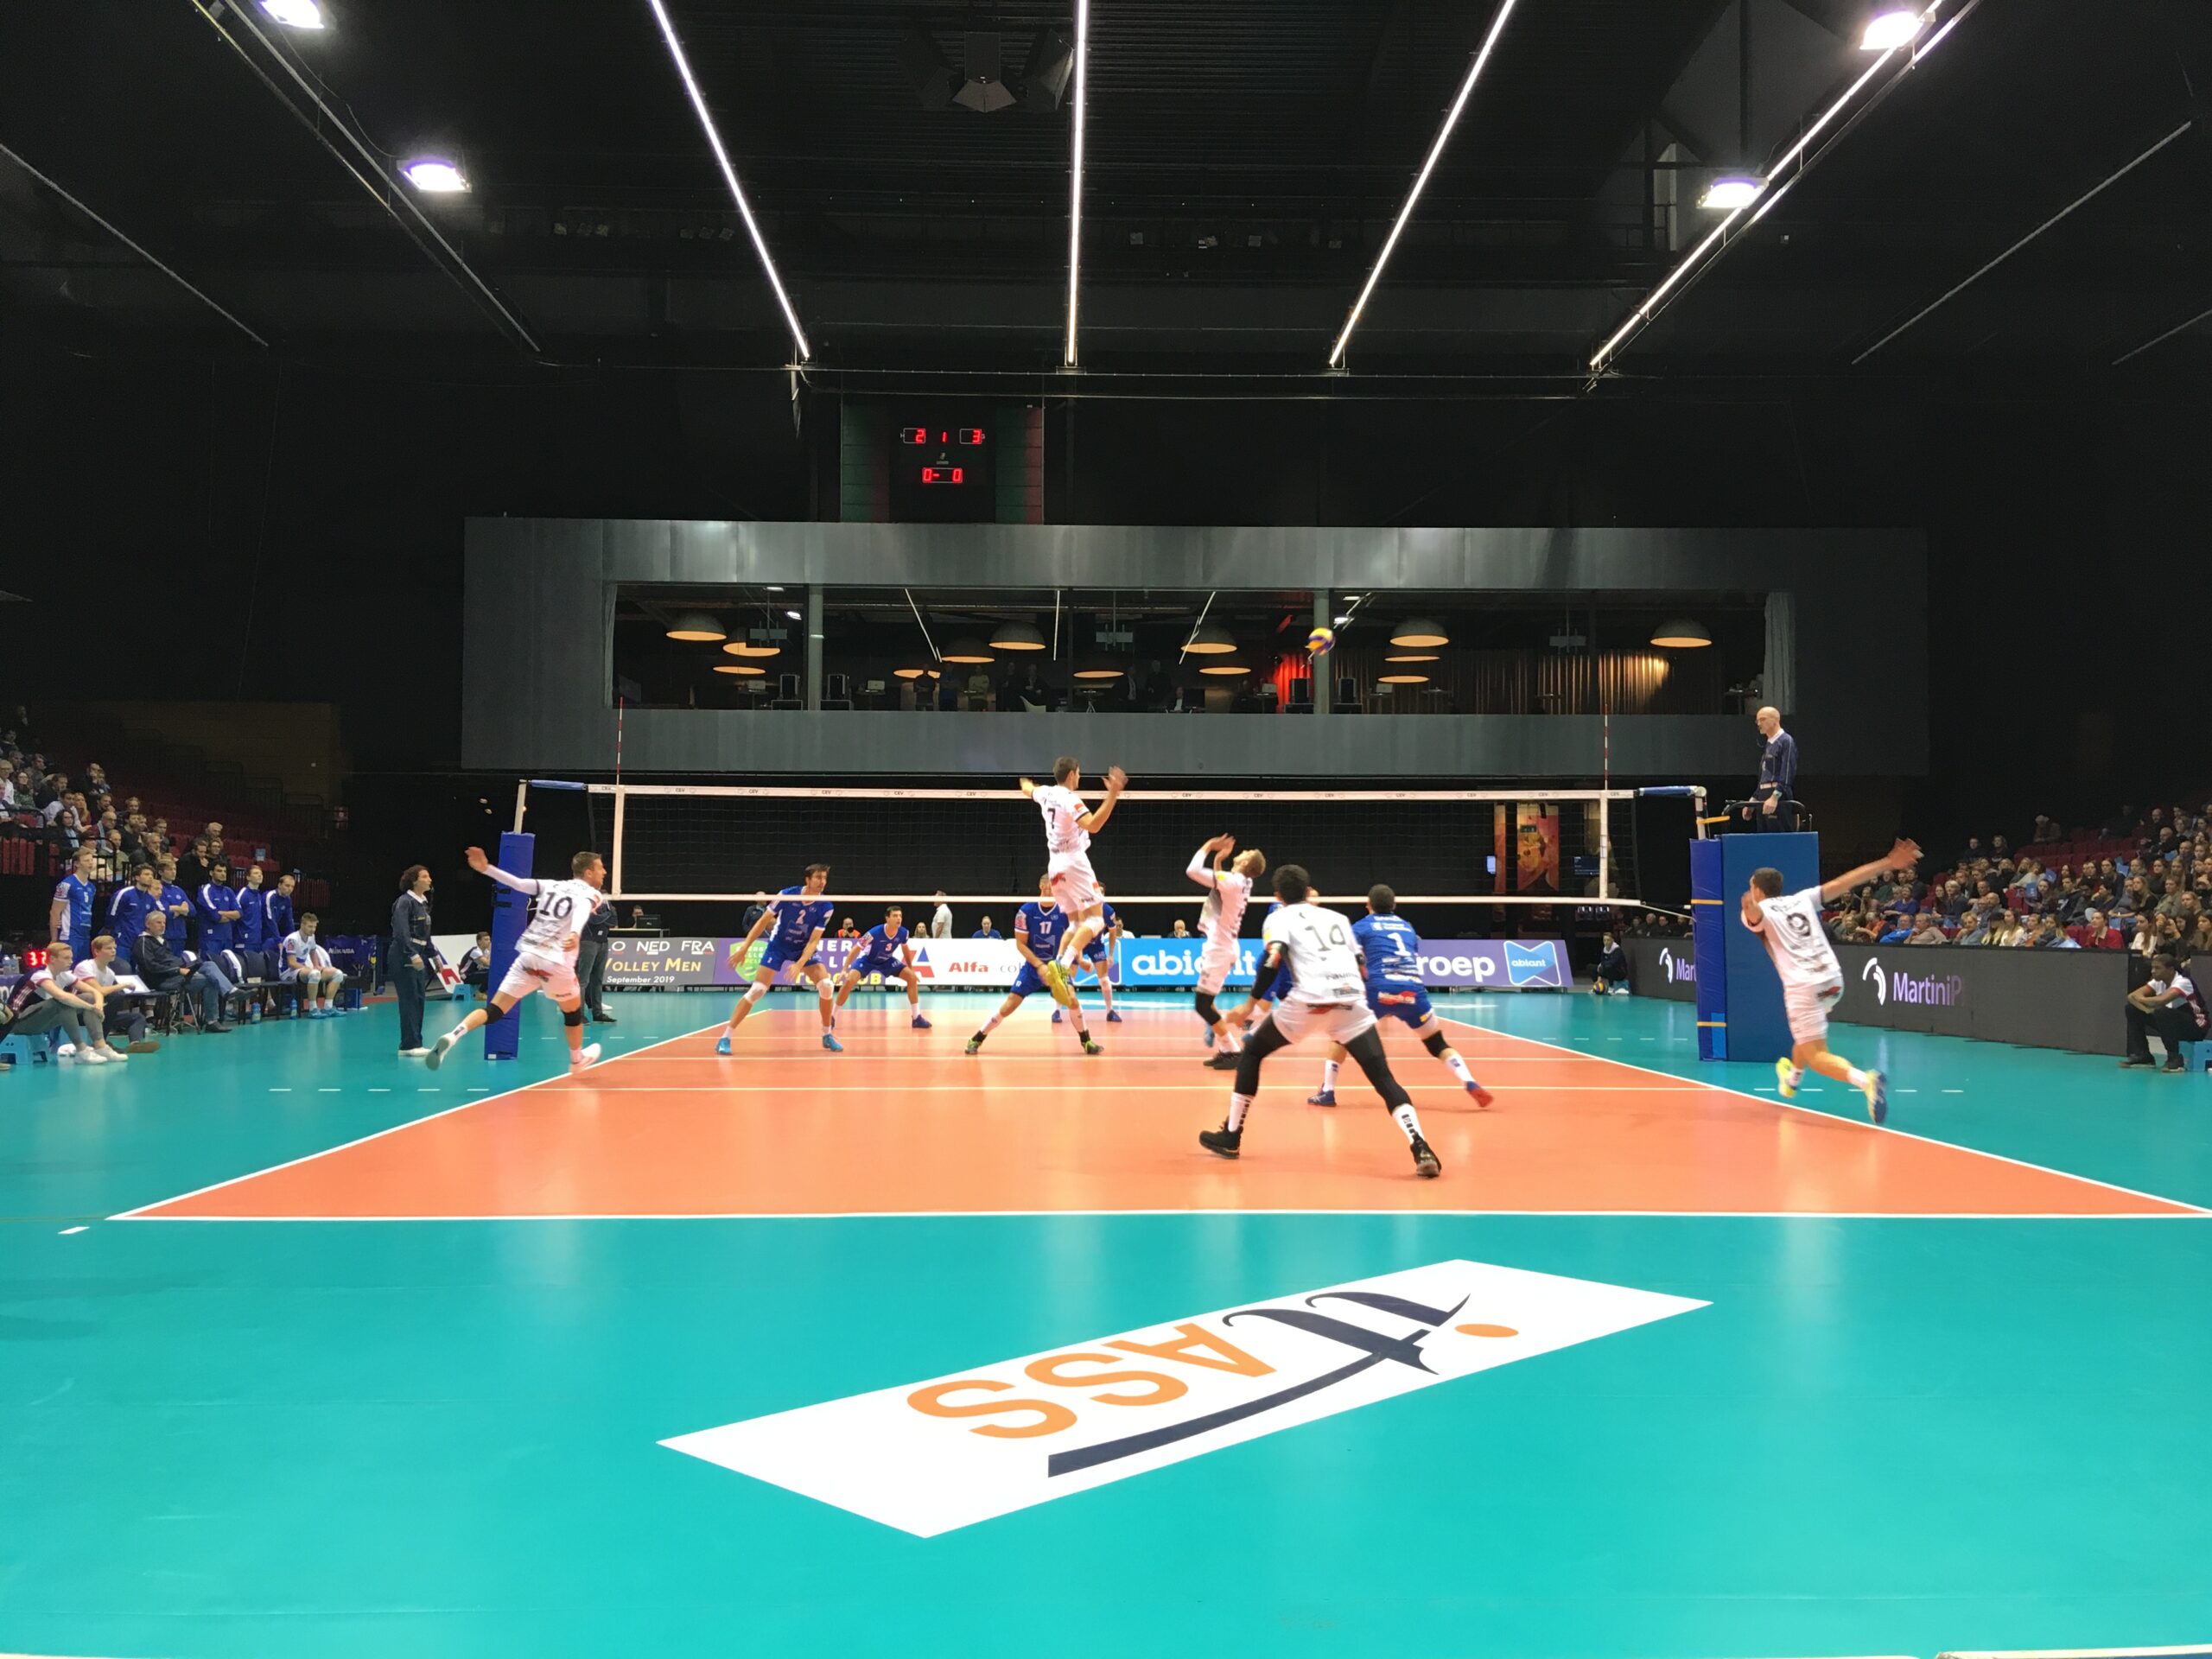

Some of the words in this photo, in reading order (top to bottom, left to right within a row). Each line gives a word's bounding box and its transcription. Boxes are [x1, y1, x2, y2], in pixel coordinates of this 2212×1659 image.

[916, 429, 925, 442] 2
[942, 431, 947, 442] 1
[972, 429, 982, 443] 3
[953, 468, 962, 481] 0
[1047, 807, 1056, 830] 7
[539, 892, 573, 919] 10
[796, 909, 806, 925] 2
[1039, 921, 1052, 934] 17
[1786, 912, 1811, 937] 9
[636, 941, 671, 951] NED
[681, 940, 715, 951] FRA
[886, 943, 893, 951] 3
[1387, 932, 1411, 957] 1
[949, 961, 988, 973] Alfa
[1132, 950, 1256, 976] abit
[1416, 955, 1496, 982] roep
[1511, 958, 1546, 967] abiant
[607, 975, 652, 984] September
